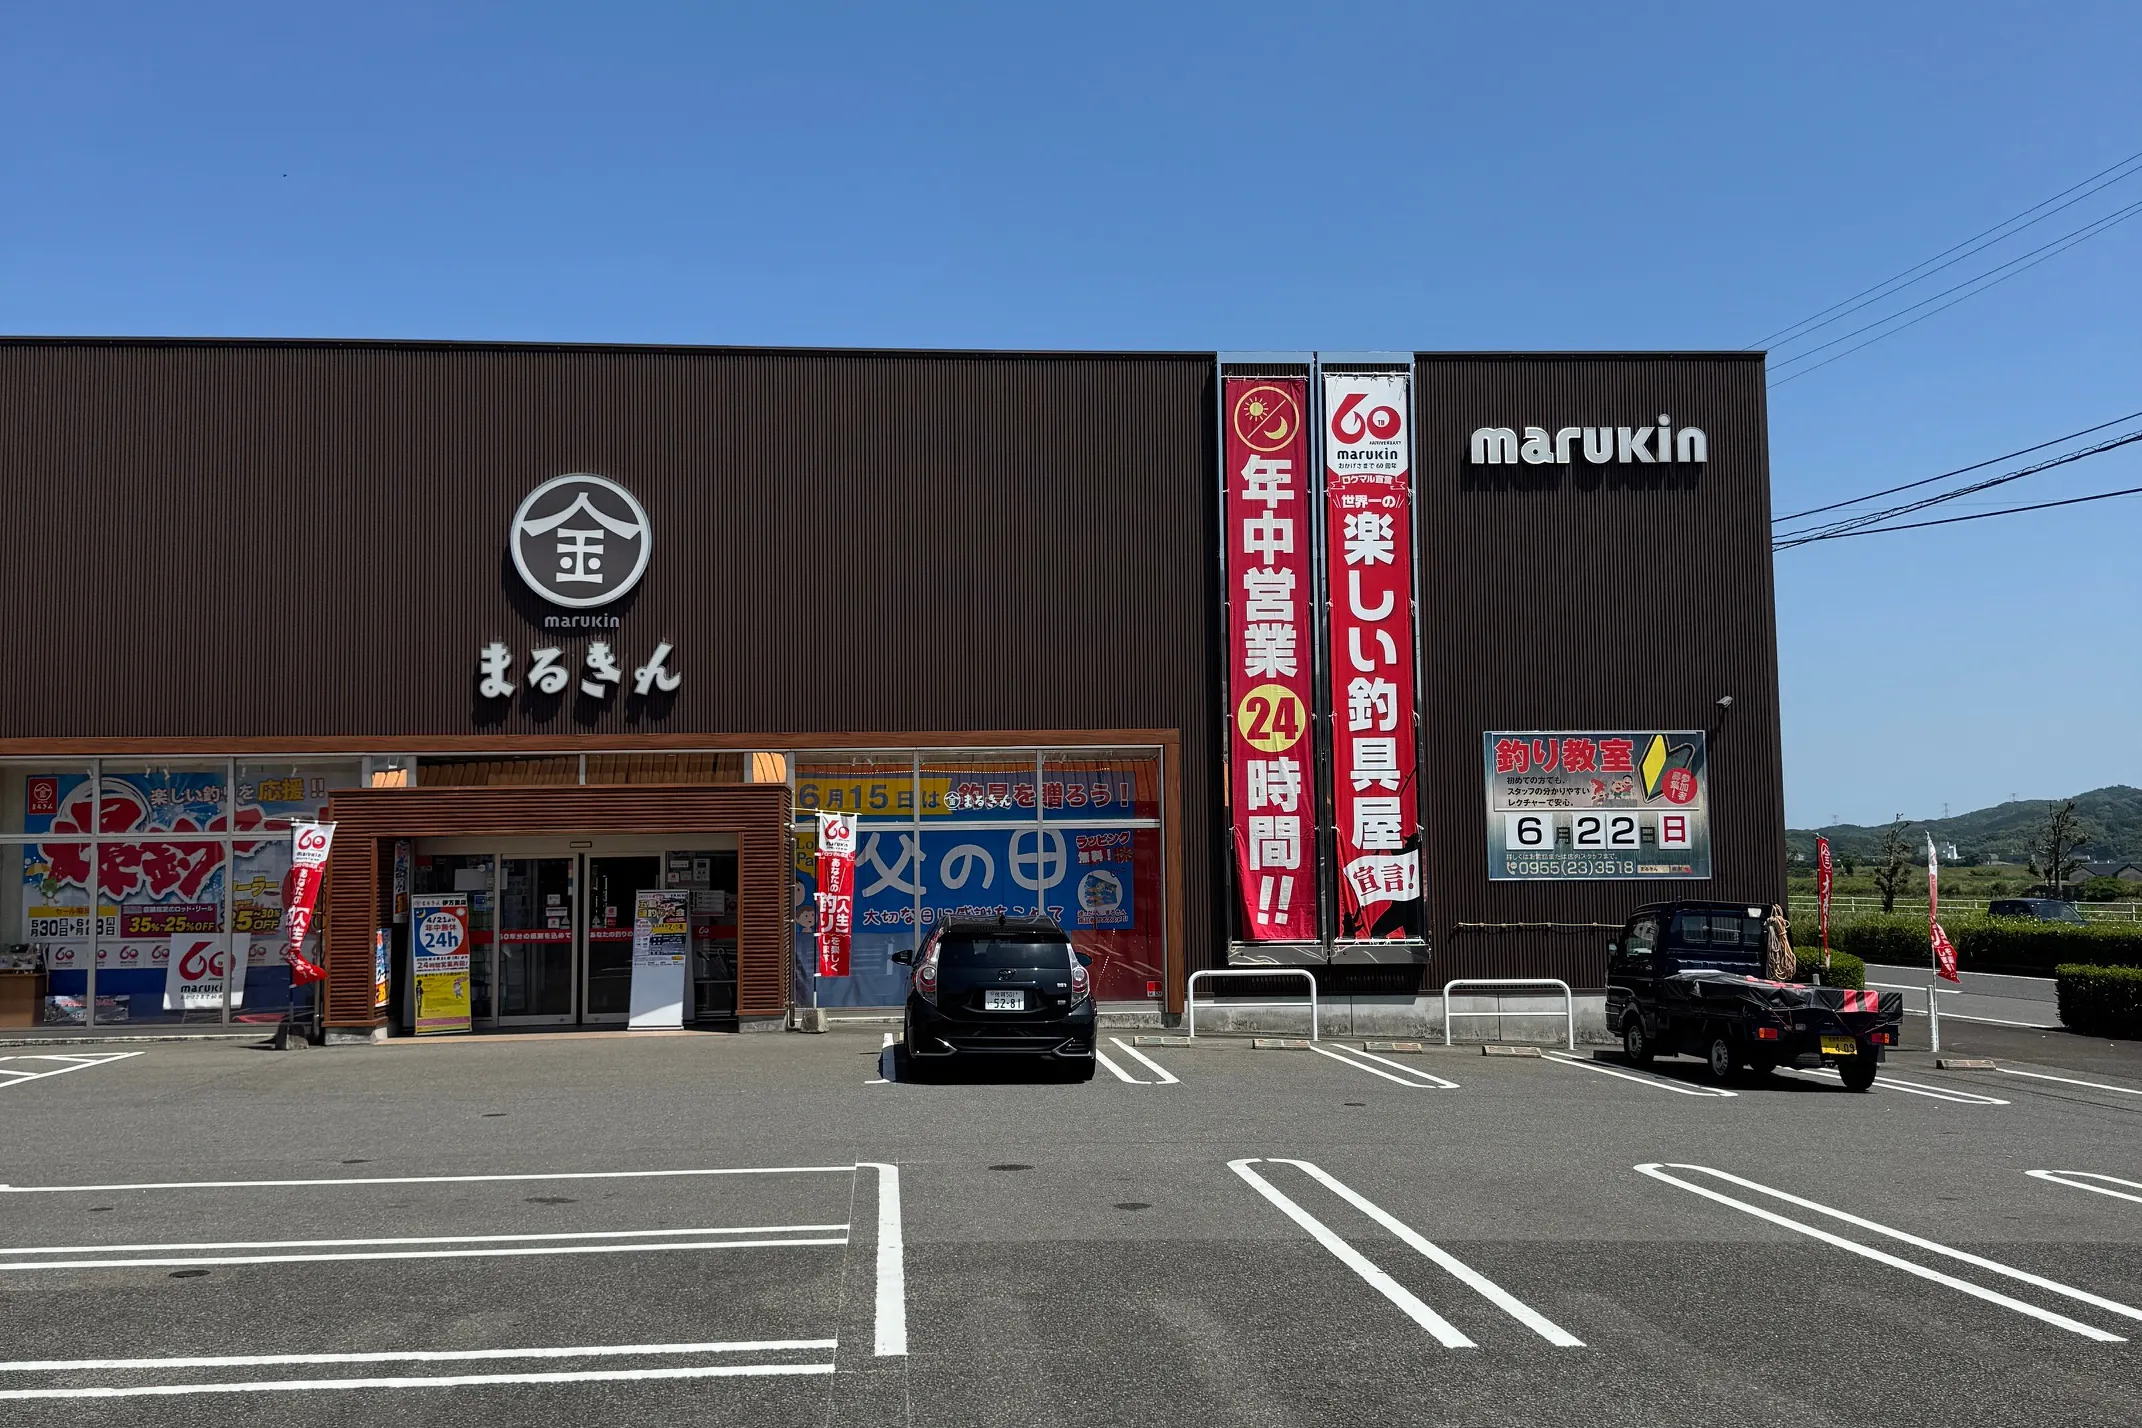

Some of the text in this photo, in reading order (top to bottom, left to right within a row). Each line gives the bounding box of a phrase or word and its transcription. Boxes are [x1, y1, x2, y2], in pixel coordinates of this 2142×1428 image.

[1332, 394, 1401, 444] 60
[1471, 413, 1707, 464] marukin
[1337, 447, 1398, 460] marukin
[1341, 494, 1396, 508] 世界一の
[544, 613, 620, 628] marukin
[479, 641, 682, 698] まるきん
[1343, 511, 1403, 850] 楽しい釣具屋
[1495, 738, 1634, 774] 釣り教室
[799, 784, 940, 809] 6月15日は
[1507, 787, 1590, 797] スタッフの分かりやすい
[1508, 798, 1574, 808] レクチャーで安心。
[824, 820, 850, 840] 60
[1076, 831, 1131, 848] ラッピング
[829, 858, 841, 892] あなたの
[1519, 861, 1634, 875] 0955(23)3518
[1353, 862, 1415, 897] 宣言!
[40, 919, 58, 937] 30
[425, 932, 459, 948] 24h
[180, 983, 227, 993] maruki
